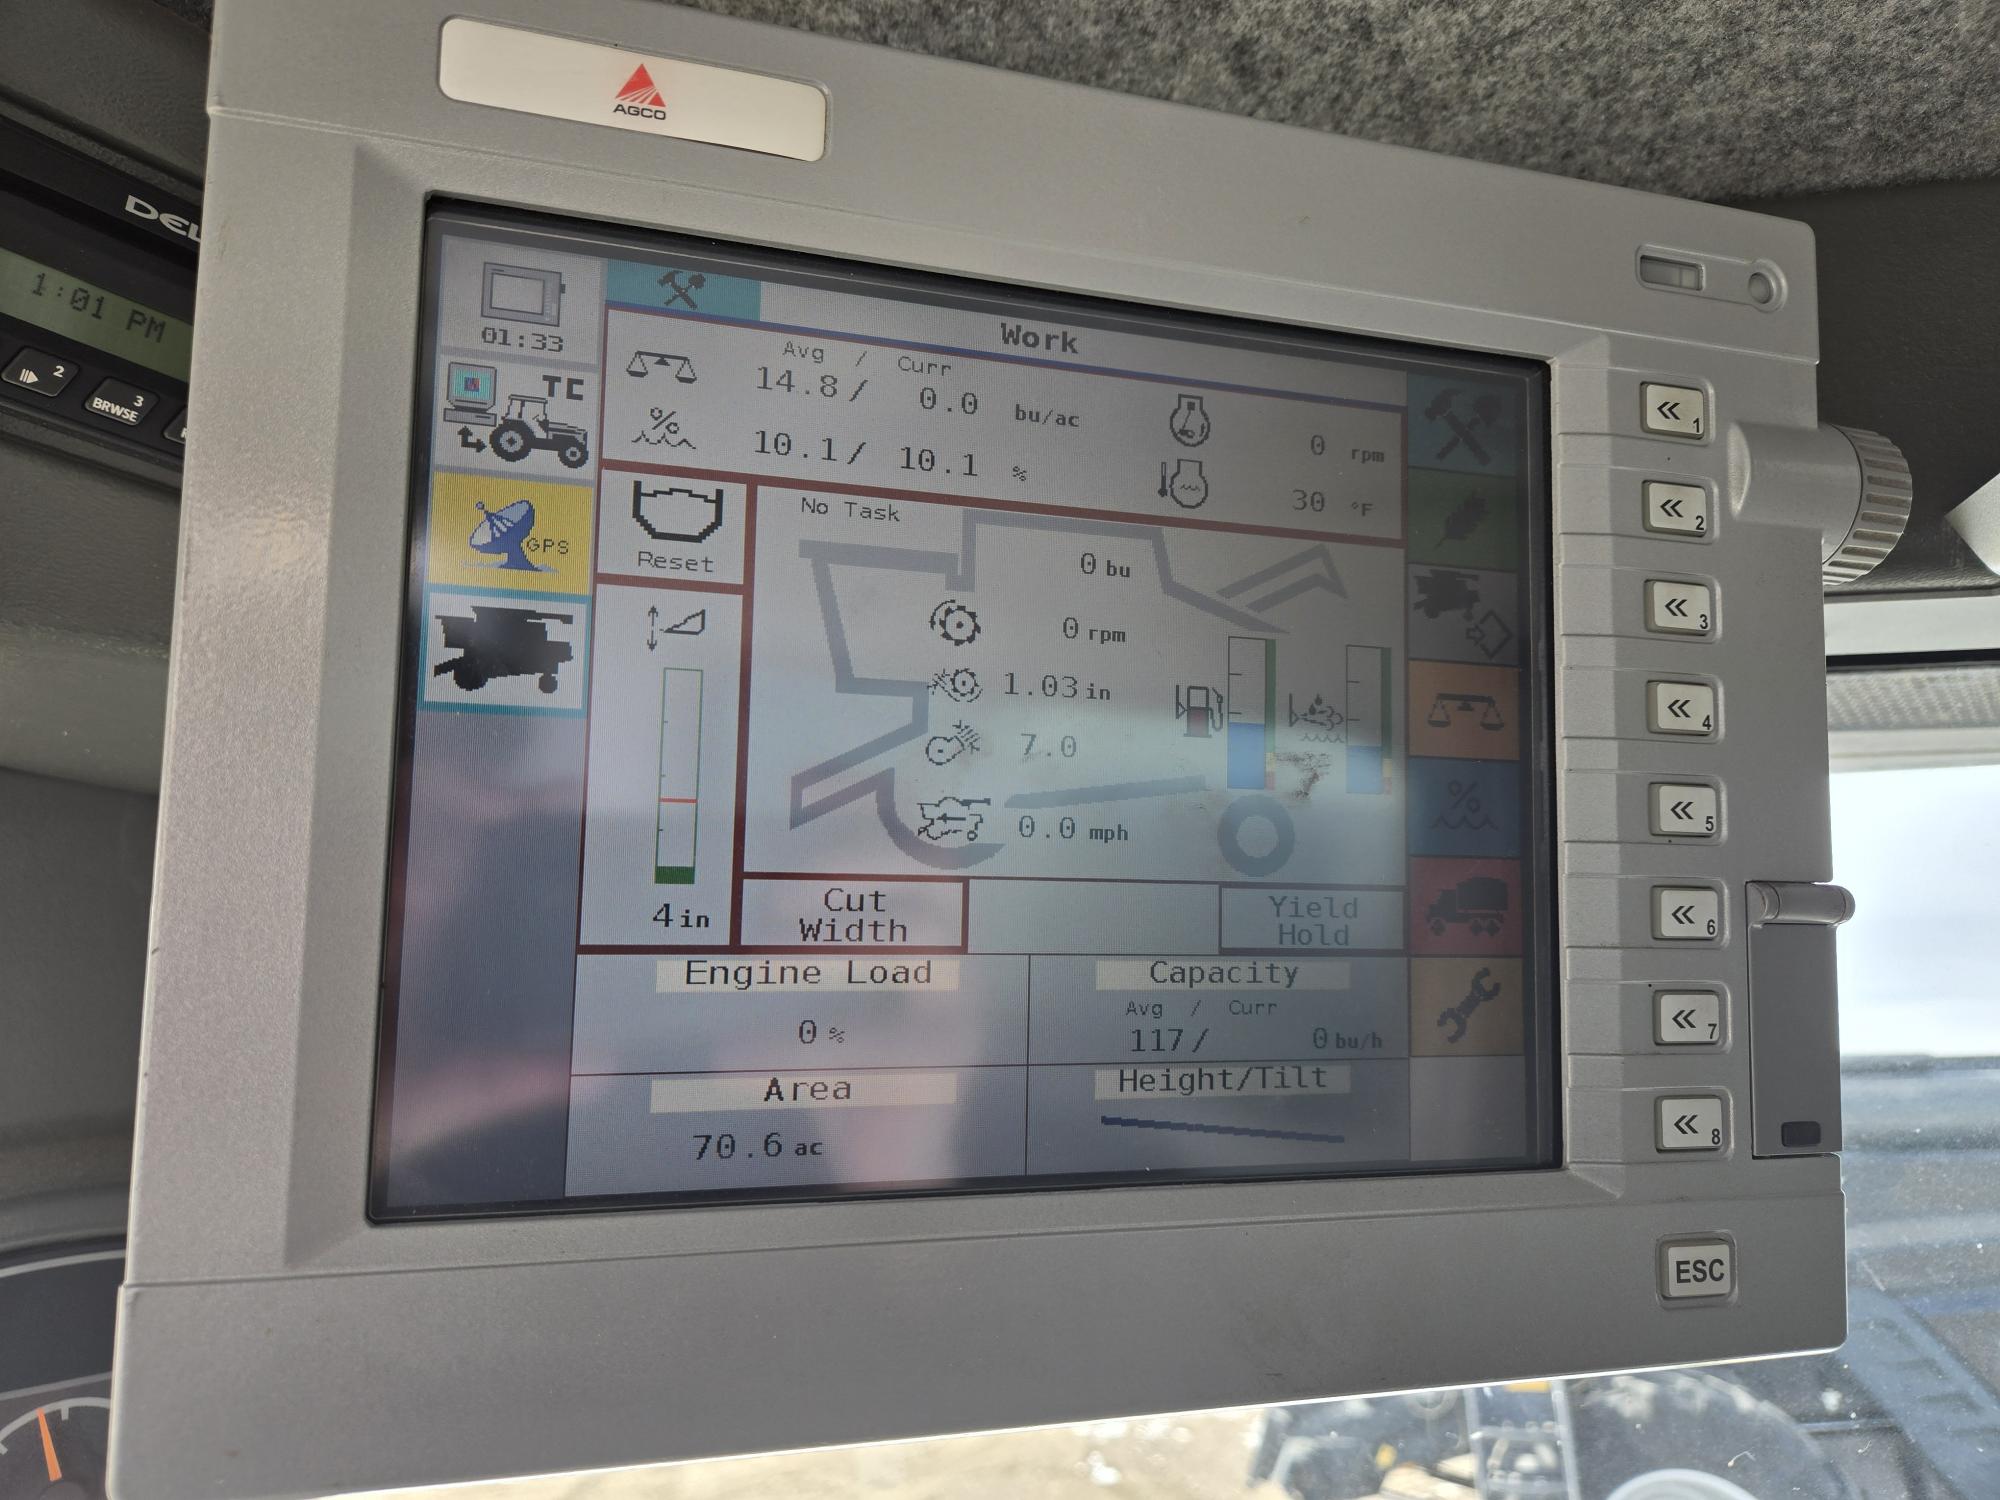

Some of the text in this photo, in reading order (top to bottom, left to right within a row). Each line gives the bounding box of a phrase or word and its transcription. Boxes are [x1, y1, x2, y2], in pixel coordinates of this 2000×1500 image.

[613, 104, 666, 120] AGCO
[32, 273, 166, 343] 1:01 PM
[482, 327, 563, 352] 01:33
[1000, 323, 1079, 354] Work
[783, 340, 825, 363] Avg
[898, 355, 951, 376] Curr
[53, 365, 65, 378] 2
[542, 375, 585, 400] TC
[92, 397, 139, 422] BRWSE
[134, 395, 144, 407] 3
[920, 387, 978, 415] 0.0
[1014, 403, 1080, 428] bu/ac
[1692, 418, 1701, 433] 1
[1310, 434, 1385, 464] 0 rpm
[900, 446, 978, 477] 10.1
[1012, 465, 1027, 482] %
[801, 497, 900, 523] No Task
[1292, 488, 1325, 513] 30
[1695, 515, 1705, 531] 2
[526, 538, 569, 554] GPS
[638, 551, 714, 573] Reset
[1081, 553, 1130, 578] 0 bu
[1063, 617, 1126, 644] 0 rpm
[1699, 614, 1709, 630] 3
[1702, 715, 1712, 730] 4
[1020, 733, 1077, 758] 7.0
[1019, 815, 1129, 843] 0.0 mph
[1705, 816, 1714, 832] 5
[824, 888, 886, 913] Cut
[1269, 895, 1359, 919] Yield
[799, 917, 908, 943] Width
[1277, 924, 1350, 946] Hold
[1706, 919, 1716, 936] 6
[686, 959, 932, 990] Engine Load
[1150, 960, 1299, 988] Capacity
[1125, 1001, 1164, 1019] Avg
[1228, 1000, 1278, 1016] Curr
[799, 1020, 846, 1044] 0 %
[1708, 1023, 1717, 1040] 7
[764, 1077, 852, 1102] Area
[1118, 1065, 1327, 1096] Height/Tilt
[693, 1133, 823, 1160] 70.6 ac
[1711, 1128, 1721, 1145] 8
[1675, 1259, 1725, 1285] ESC
